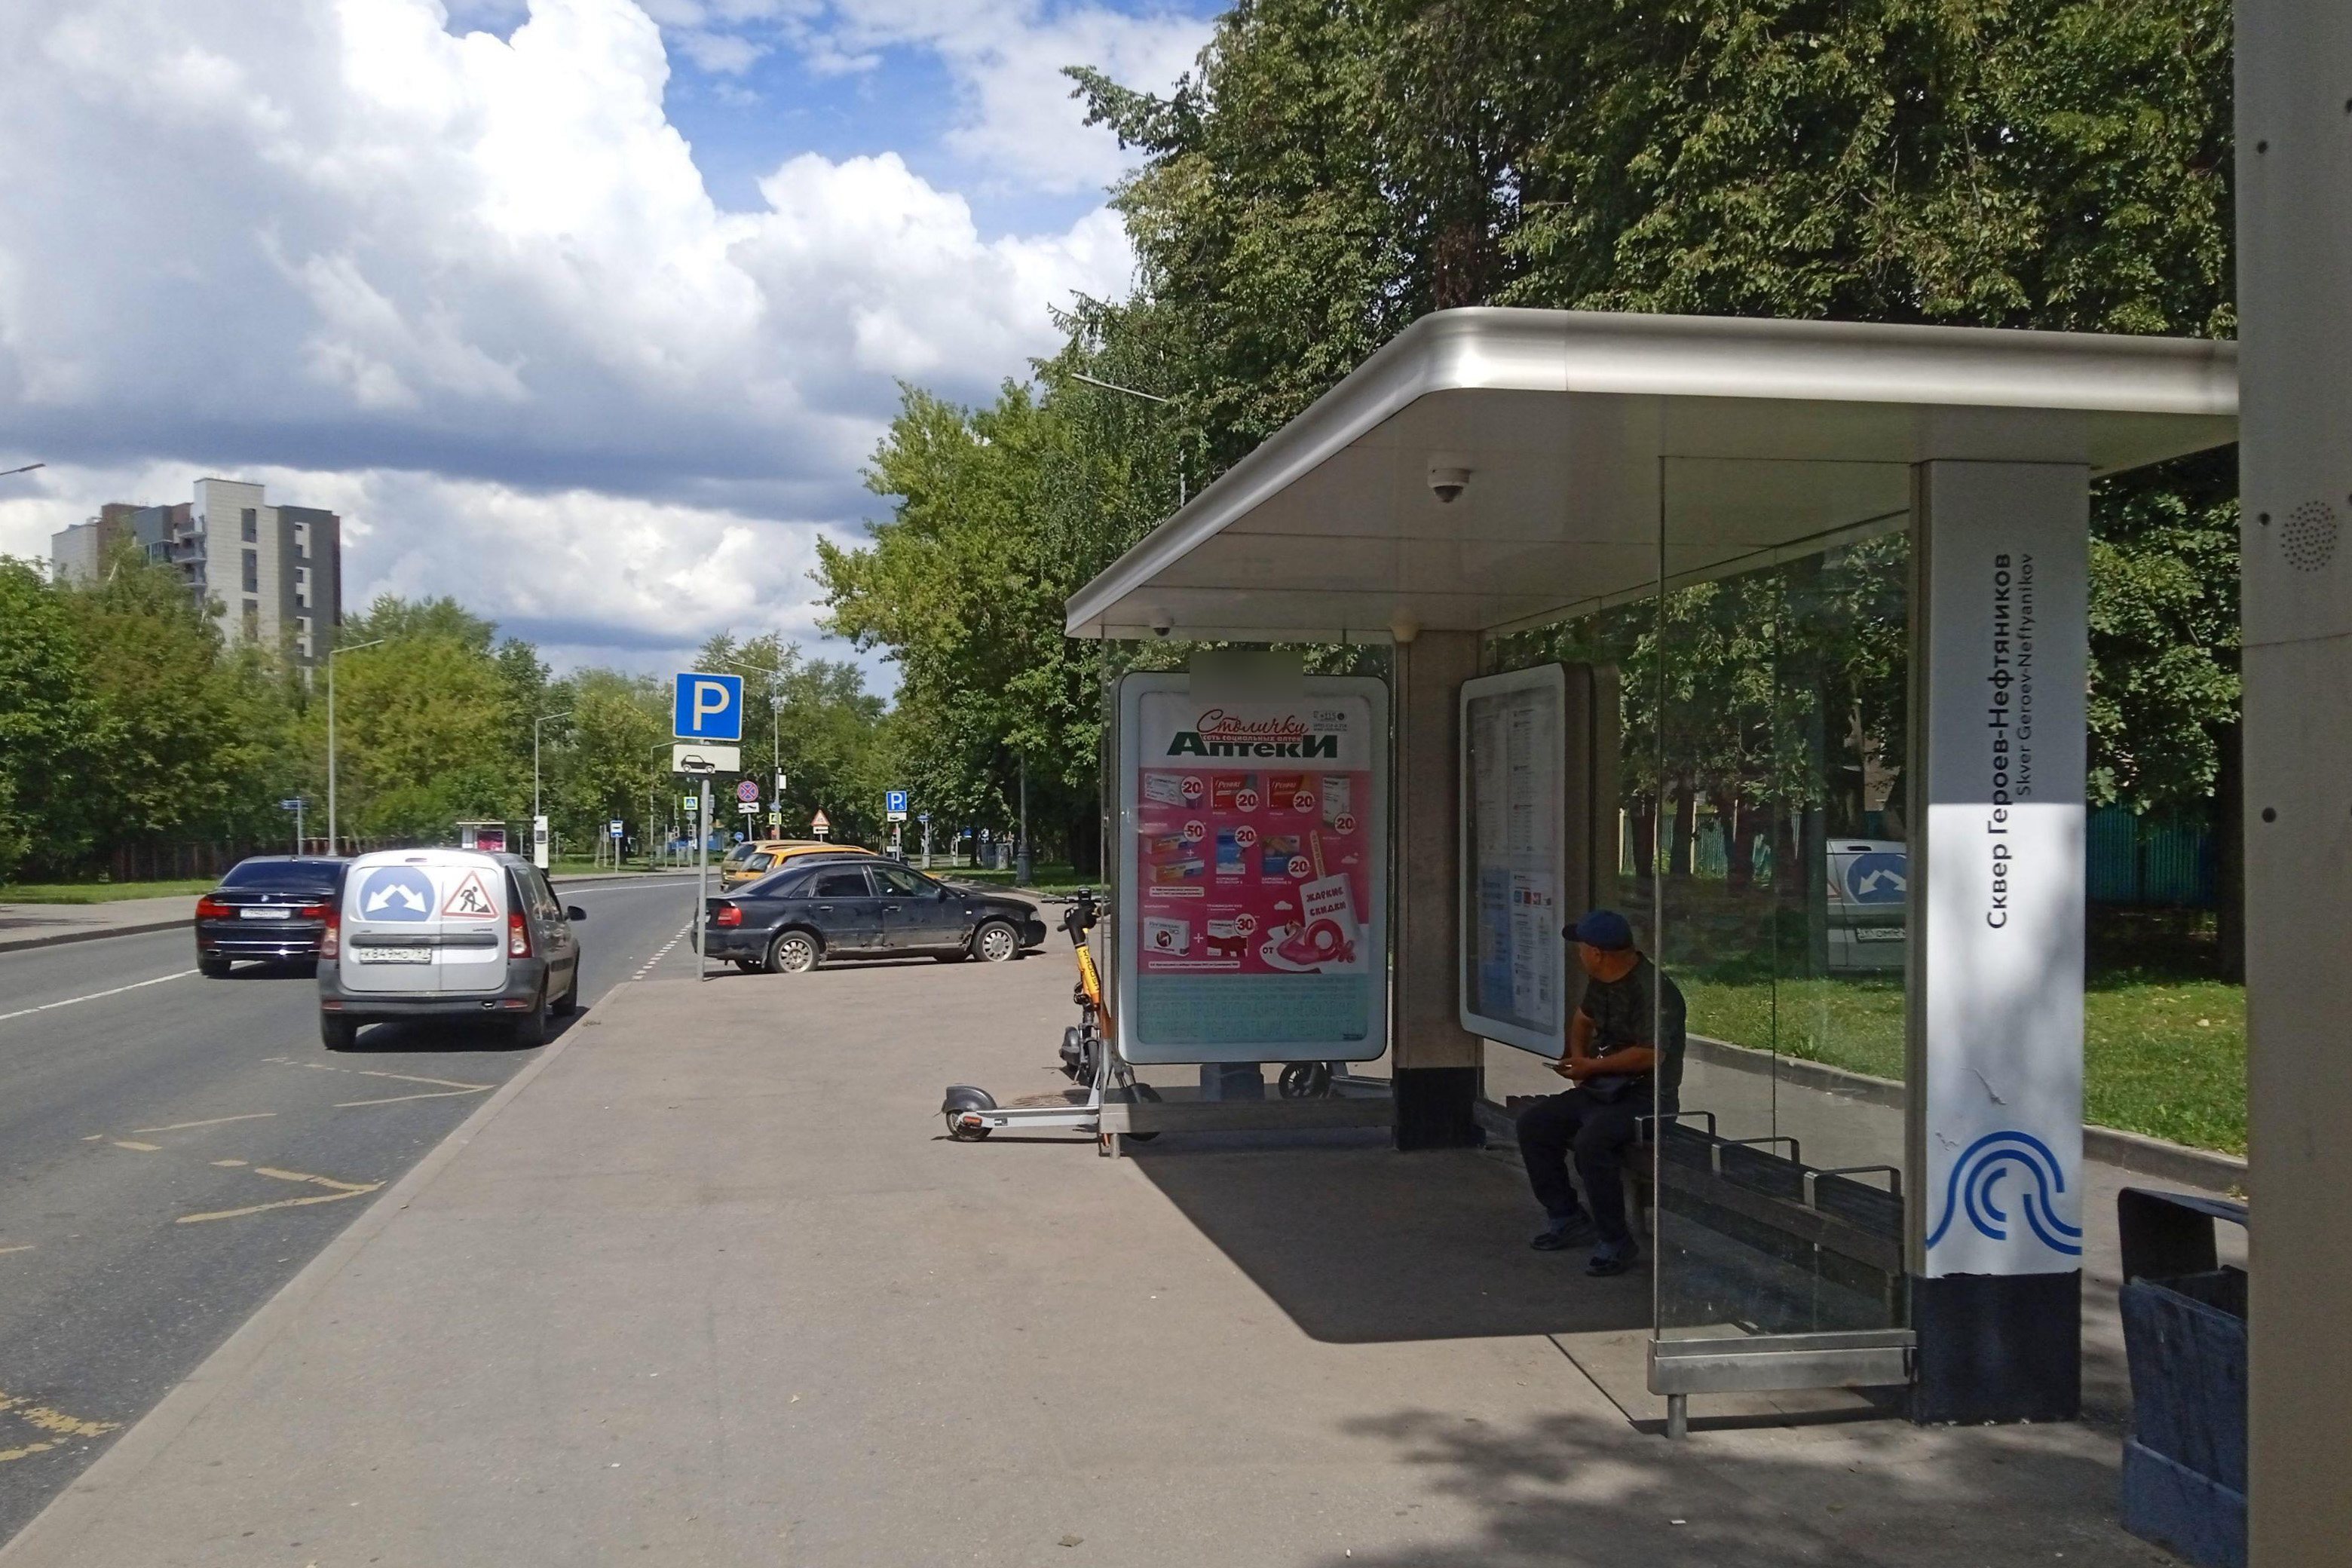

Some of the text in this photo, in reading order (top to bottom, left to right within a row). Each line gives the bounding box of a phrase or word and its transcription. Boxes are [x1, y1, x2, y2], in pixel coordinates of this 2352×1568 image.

[2016, 553, 2035, 796] Skver Geroev-Neftyanikov
[1196, 709, 1309, 734] Столички
[1222, 734, 1276, 743] социальных
[1986, 553, 2014, 929] Сквер Героев-Нефтяников
[1306, 887, 1344, 902] ЖАРКИЕ
[1309, 901, 1346, 916] СКИДКИ
